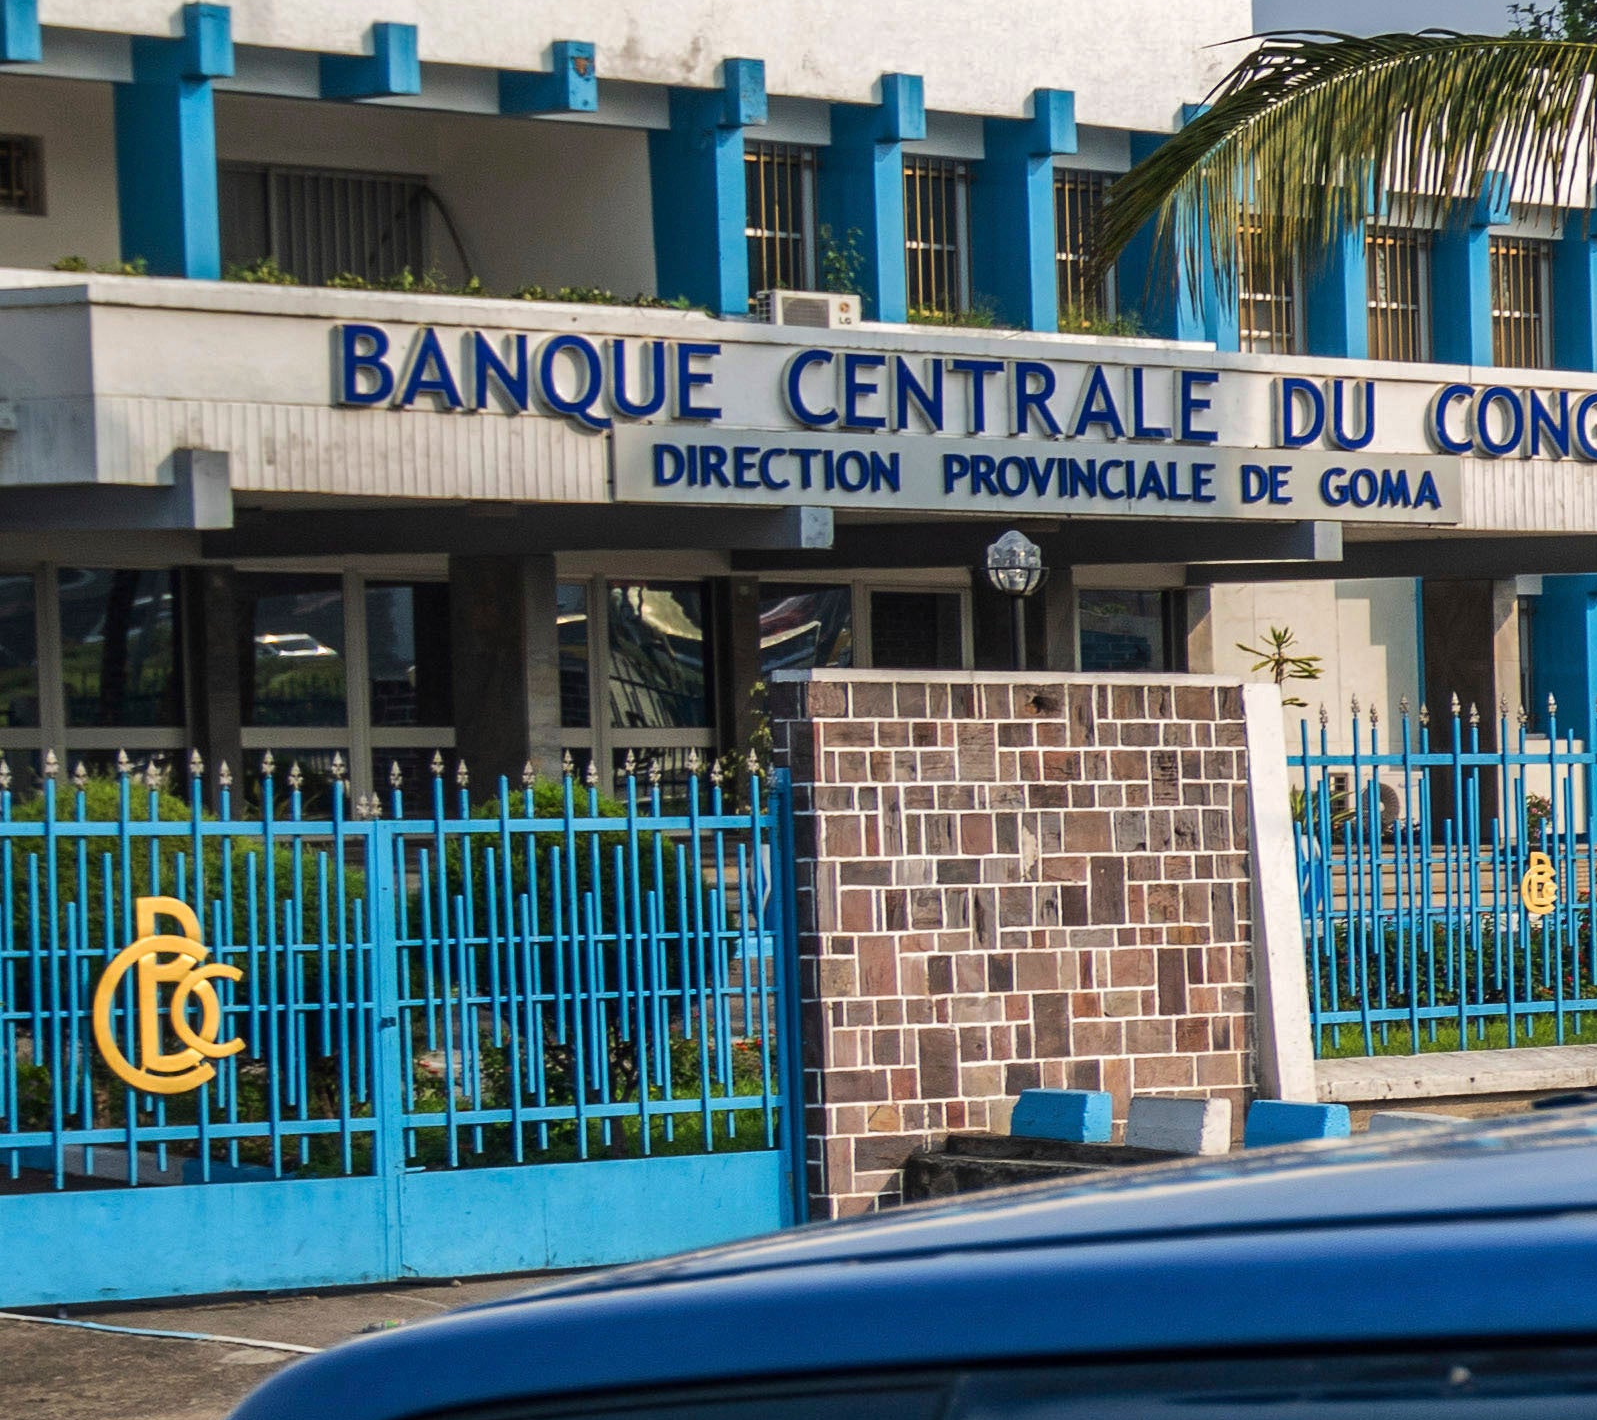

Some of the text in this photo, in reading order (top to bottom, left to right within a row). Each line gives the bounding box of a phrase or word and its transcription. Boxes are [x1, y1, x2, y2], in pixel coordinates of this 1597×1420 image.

[838, 316, 852, 325] LG
[337, 324, 722, 430] BANQUE
[784, 349, 1219, 443] CENTRALE
[1276, 376, 1375, 451] DU
[653, 444, 1442, 509] DIRECTION PROVINCIALE DE GOMA
